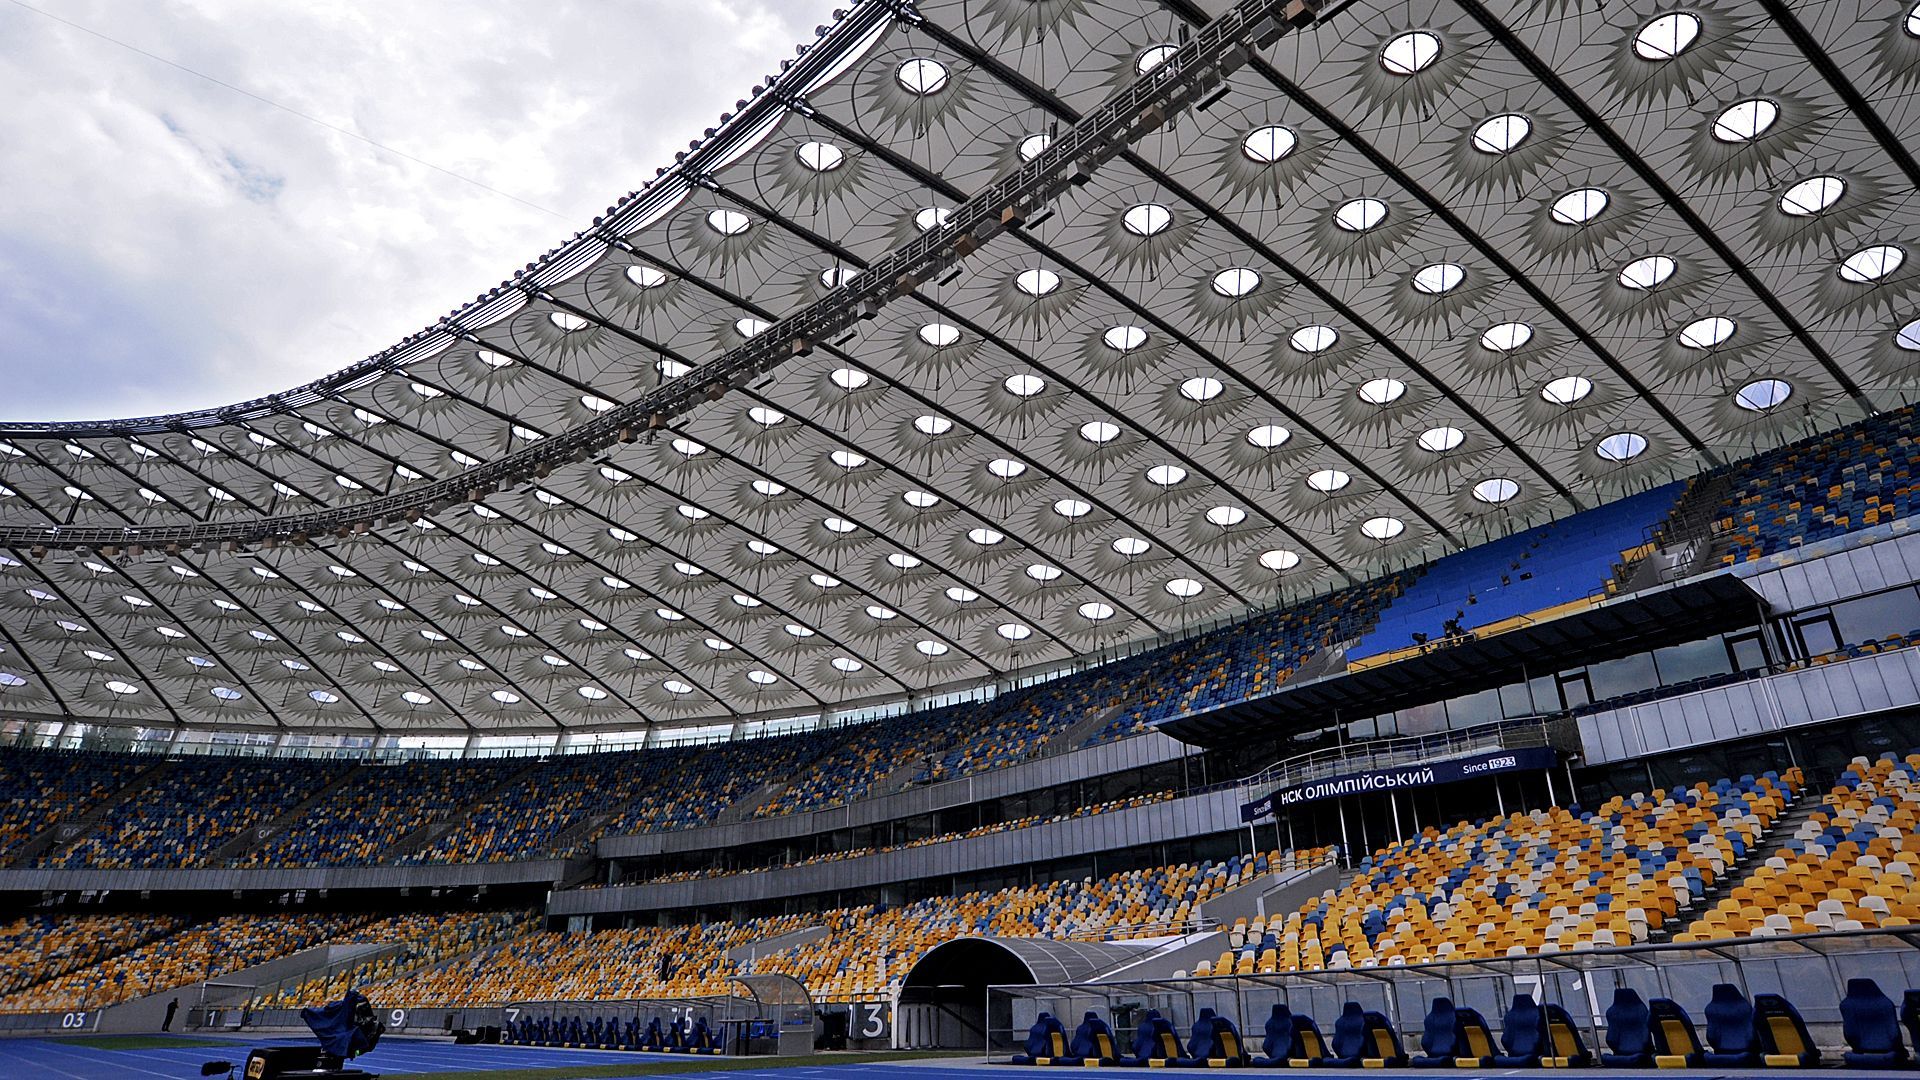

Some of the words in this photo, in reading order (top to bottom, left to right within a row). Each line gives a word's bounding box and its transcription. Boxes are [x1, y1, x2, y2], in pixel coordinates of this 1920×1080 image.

[1463, 763, 1488, 774] Since
[1489, 756, 1516, 770] 1923
[1281, 788, 1303, 805] НСК
[1305, 767, 1435, 799] ОЛІМПІЙСЬКИЙ
[62, 1012, 86, 1028] 03
[391, 1009, 405, 1027] 9
